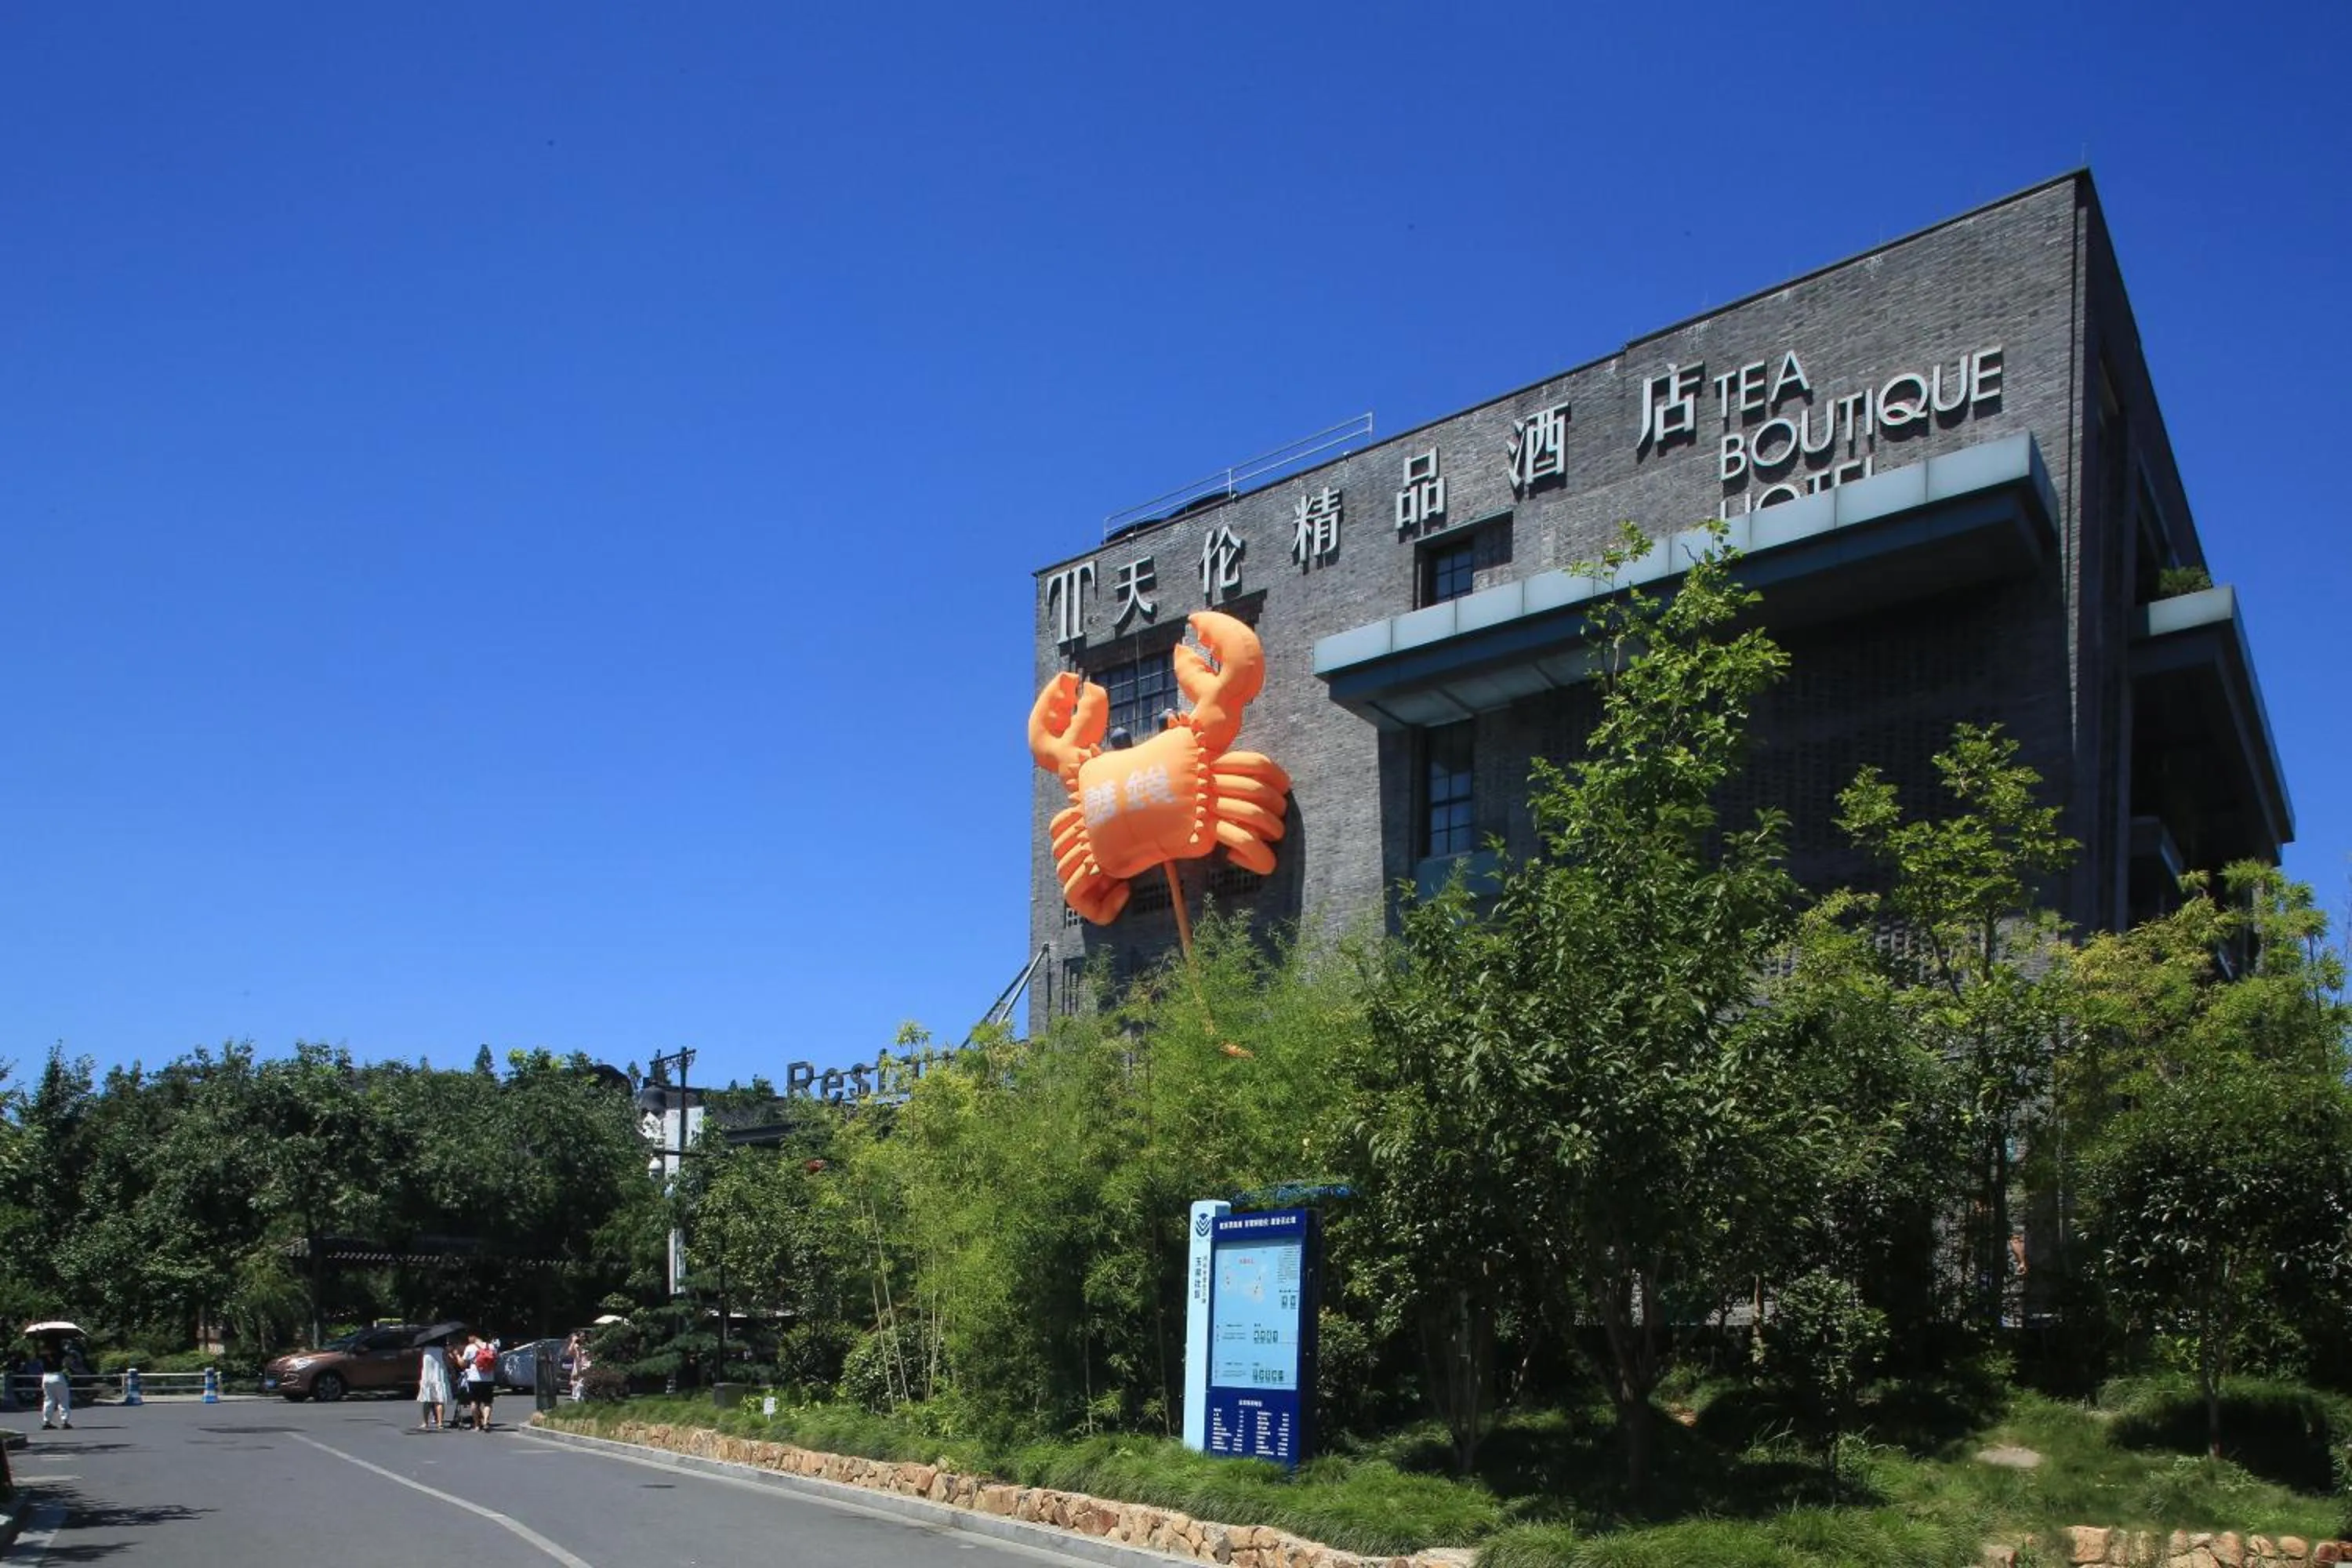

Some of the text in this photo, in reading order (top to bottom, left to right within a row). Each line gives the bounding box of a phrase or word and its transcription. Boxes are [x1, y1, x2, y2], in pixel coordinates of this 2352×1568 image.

[1714, 350, 1809, 417] TEA
[1720, 346, 2002, 481] BOUTIQUE
[1115, 361, 1704, 625] 天伦精品酒店
